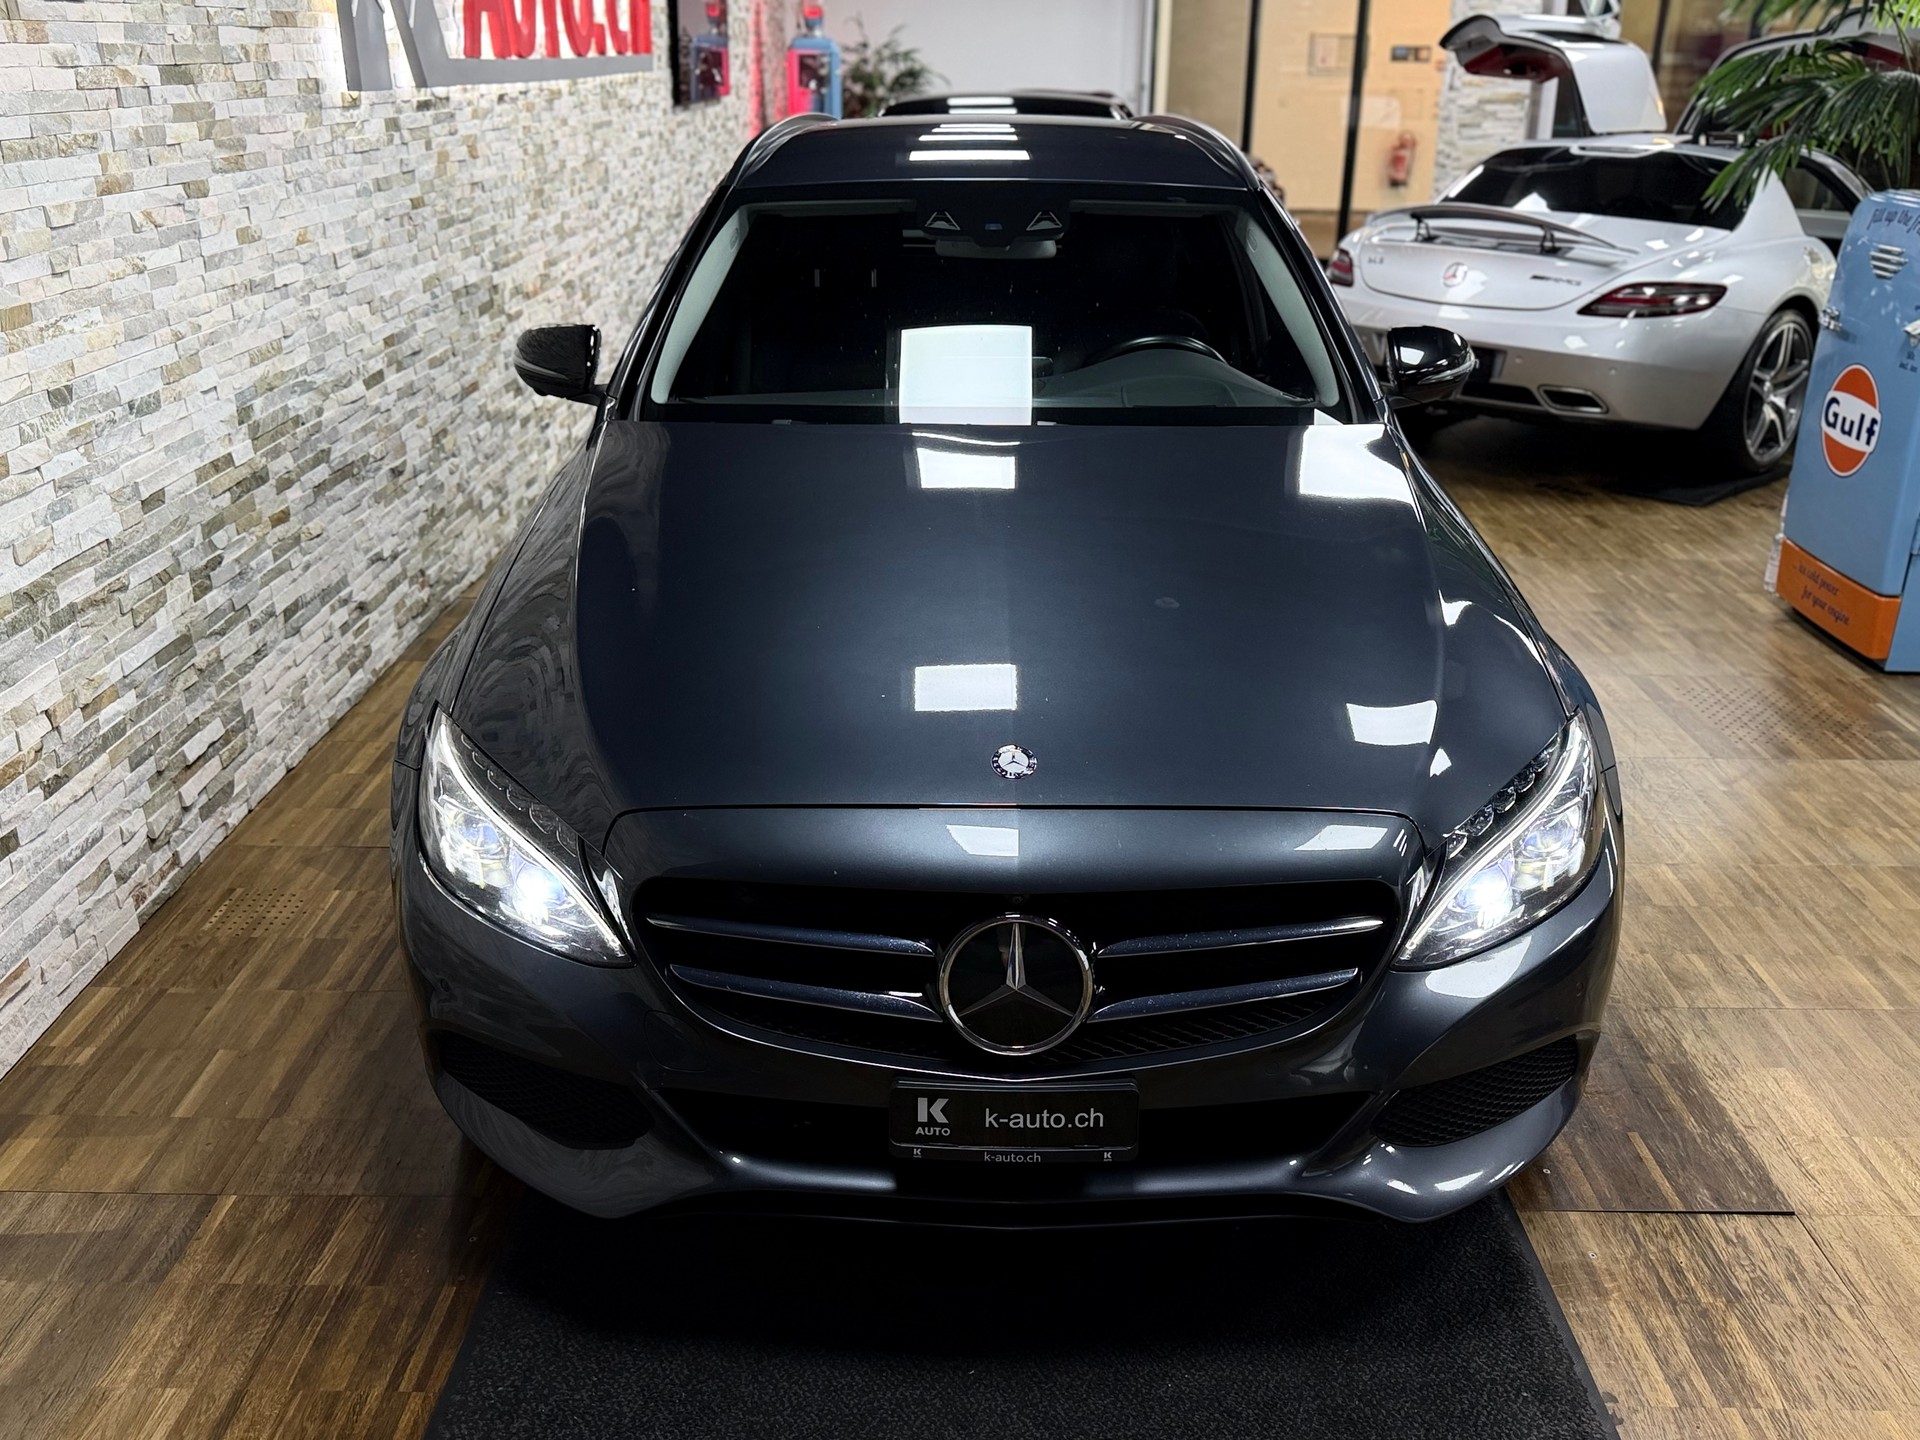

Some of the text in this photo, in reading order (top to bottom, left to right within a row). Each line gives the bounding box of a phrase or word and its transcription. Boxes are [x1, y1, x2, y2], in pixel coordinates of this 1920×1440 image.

[1824, 396, 1878, 447] Gulf
[917, 1097, 949, 1123] K
[985, 1107, 1104, 1128] k-auto.ch
[915, 1126, 951, 1136] AUTO
[984, 1151, 1041, 1163] k-auto.ch
